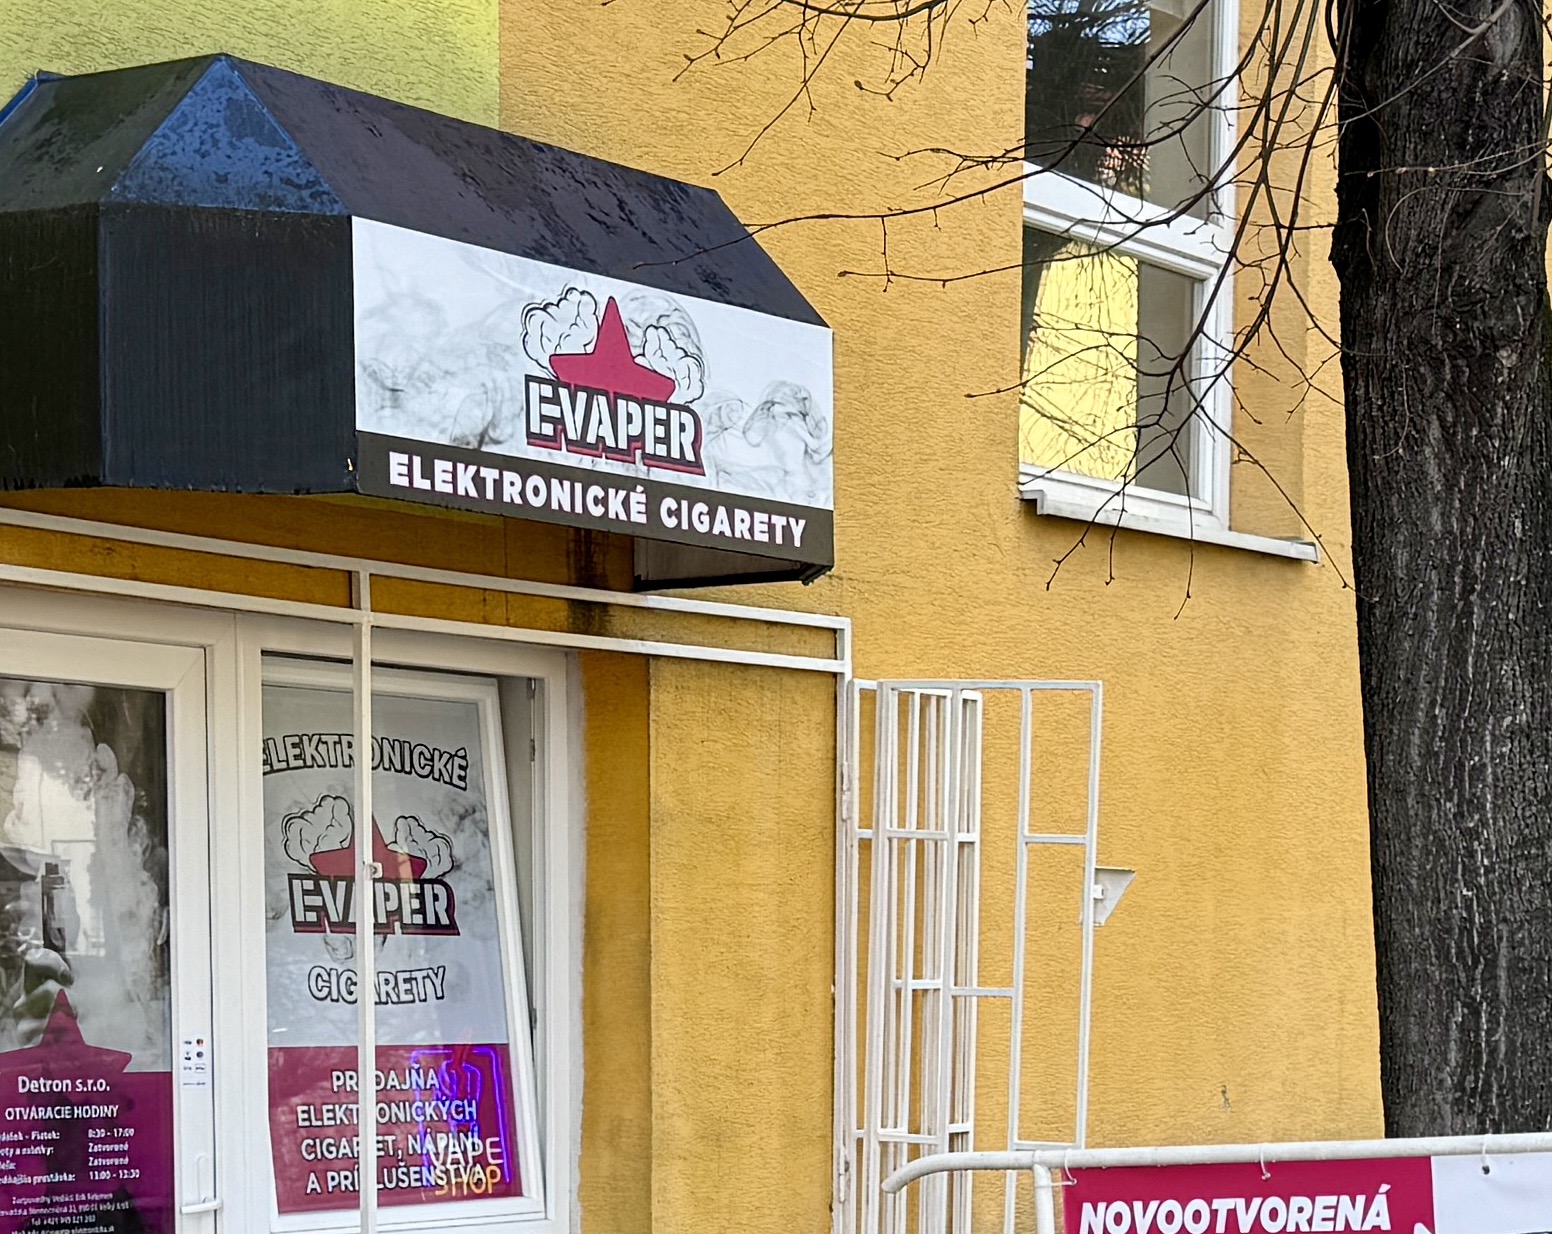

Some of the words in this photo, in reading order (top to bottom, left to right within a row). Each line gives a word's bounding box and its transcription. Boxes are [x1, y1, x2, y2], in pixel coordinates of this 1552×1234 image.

[525, 376, 704, 473] EVAPER
[390, 451, 647, 523] ELEKTRONICKÉ
[660, 498, 806, 547] CIGARETY
[288, 875, 458, 934] EVPER
[308, 965, 445, 1005] CIGRETY
[18, 1076, 72, 1094] Detron
[75, 1078, 110, 1092] s.r.o.
[332, 1063, 440, 1092] PRDAJŇA
[74, 1105, 118, 1119] HODINY
[297, 1096, 476, 1126] ELEKTONICKÝCH
[306, 1172, 322, 1194] A
[327, 1162, 486, 1192] PRÍLUŠENSTVA
